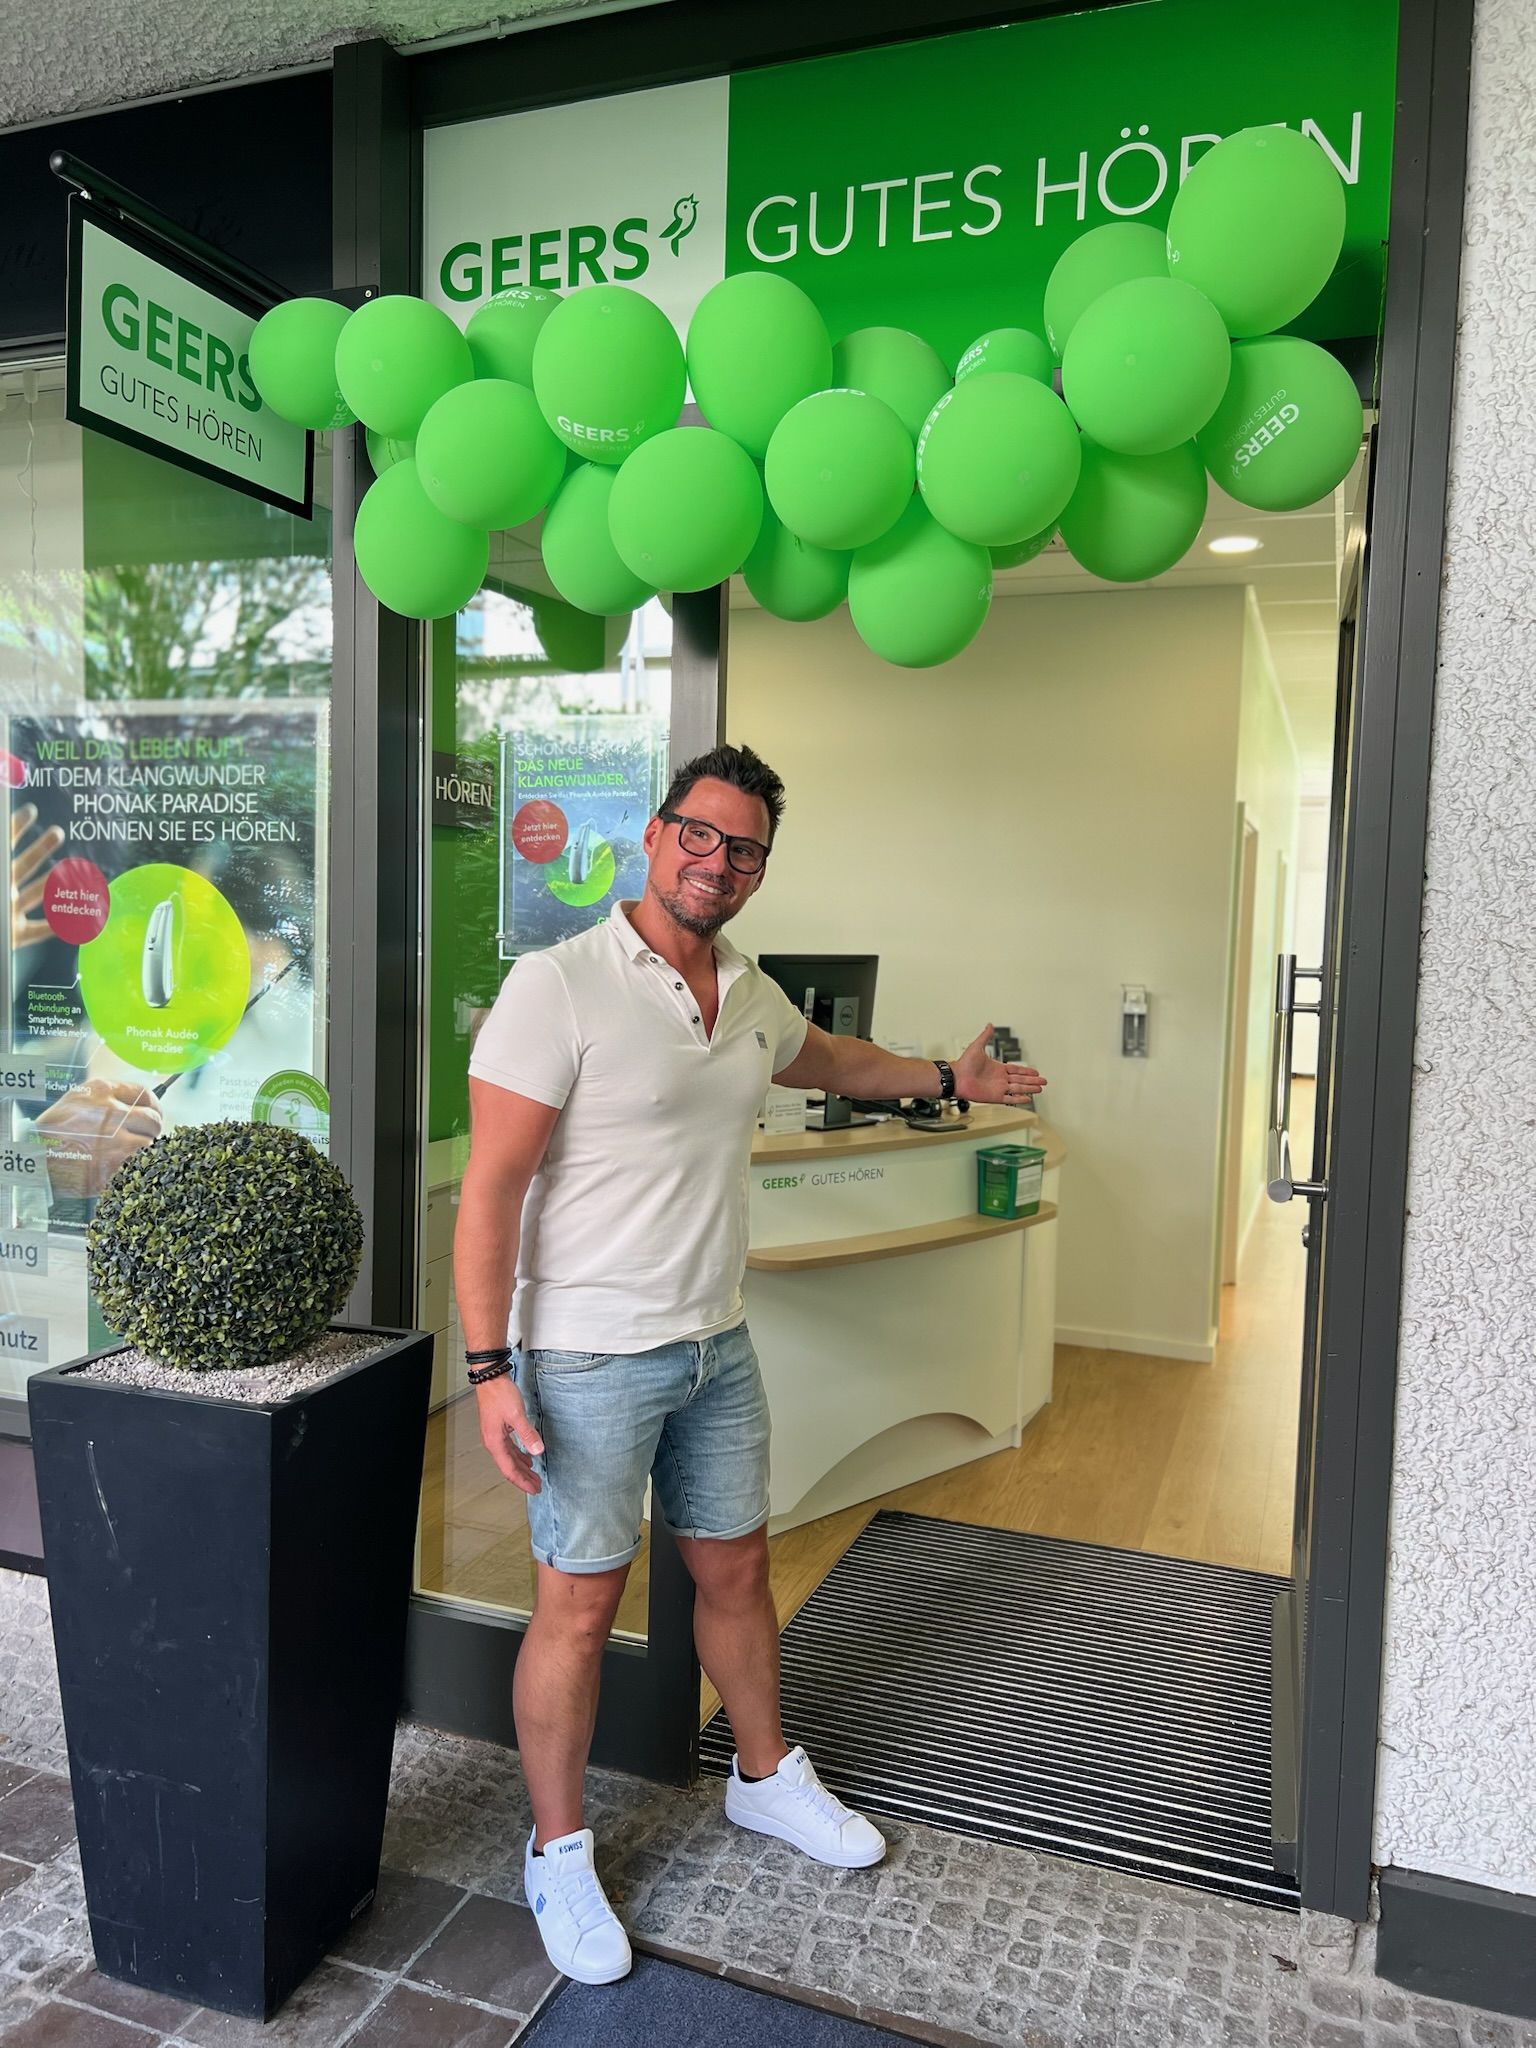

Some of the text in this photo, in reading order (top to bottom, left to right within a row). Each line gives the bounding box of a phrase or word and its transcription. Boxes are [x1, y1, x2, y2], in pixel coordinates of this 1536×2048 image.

[747, 111, 1362, 262] GUTES HÖN
[440, 218, 650, 302] GEERS
[102, 283, 263, 412] GEERS
[100, 365, 262, 462] GUTES HÖREN
[557, 415, 630, 443] GEERS
[1235, 403, 1300, 467] GEERS
[36, 741, 80, 760] WEIL
[85, 739, 124, 760] DAS
[129, 735, 190, 760] LEBEN
[25, 764, 265, 787] MIT DEM KLANGWUNDER
[517, 757, 584, 772] DAS NEUE
[435, 773, 492, 807] HÖREN
[73, 792, 258, 814] PHONAK PARADISE
[69, 816, 301, 842] KÖNNEN SIE ES HÖREN.
[521, 833, 561, 843] entdecken
[54, 888, 100, 902] Jetzt hier
[51, 903, 102, 917] entdecken
[28, 1003, 82, 1015] Anbindung an
[28, 1014, 75, 1027] Smartphone,
[126, 1025, 163, 1038] Phonak
[142, 1040, 184, 1054] Paradise
[762, 1168, 884, 1190] GEERS GUTES HÖREN
